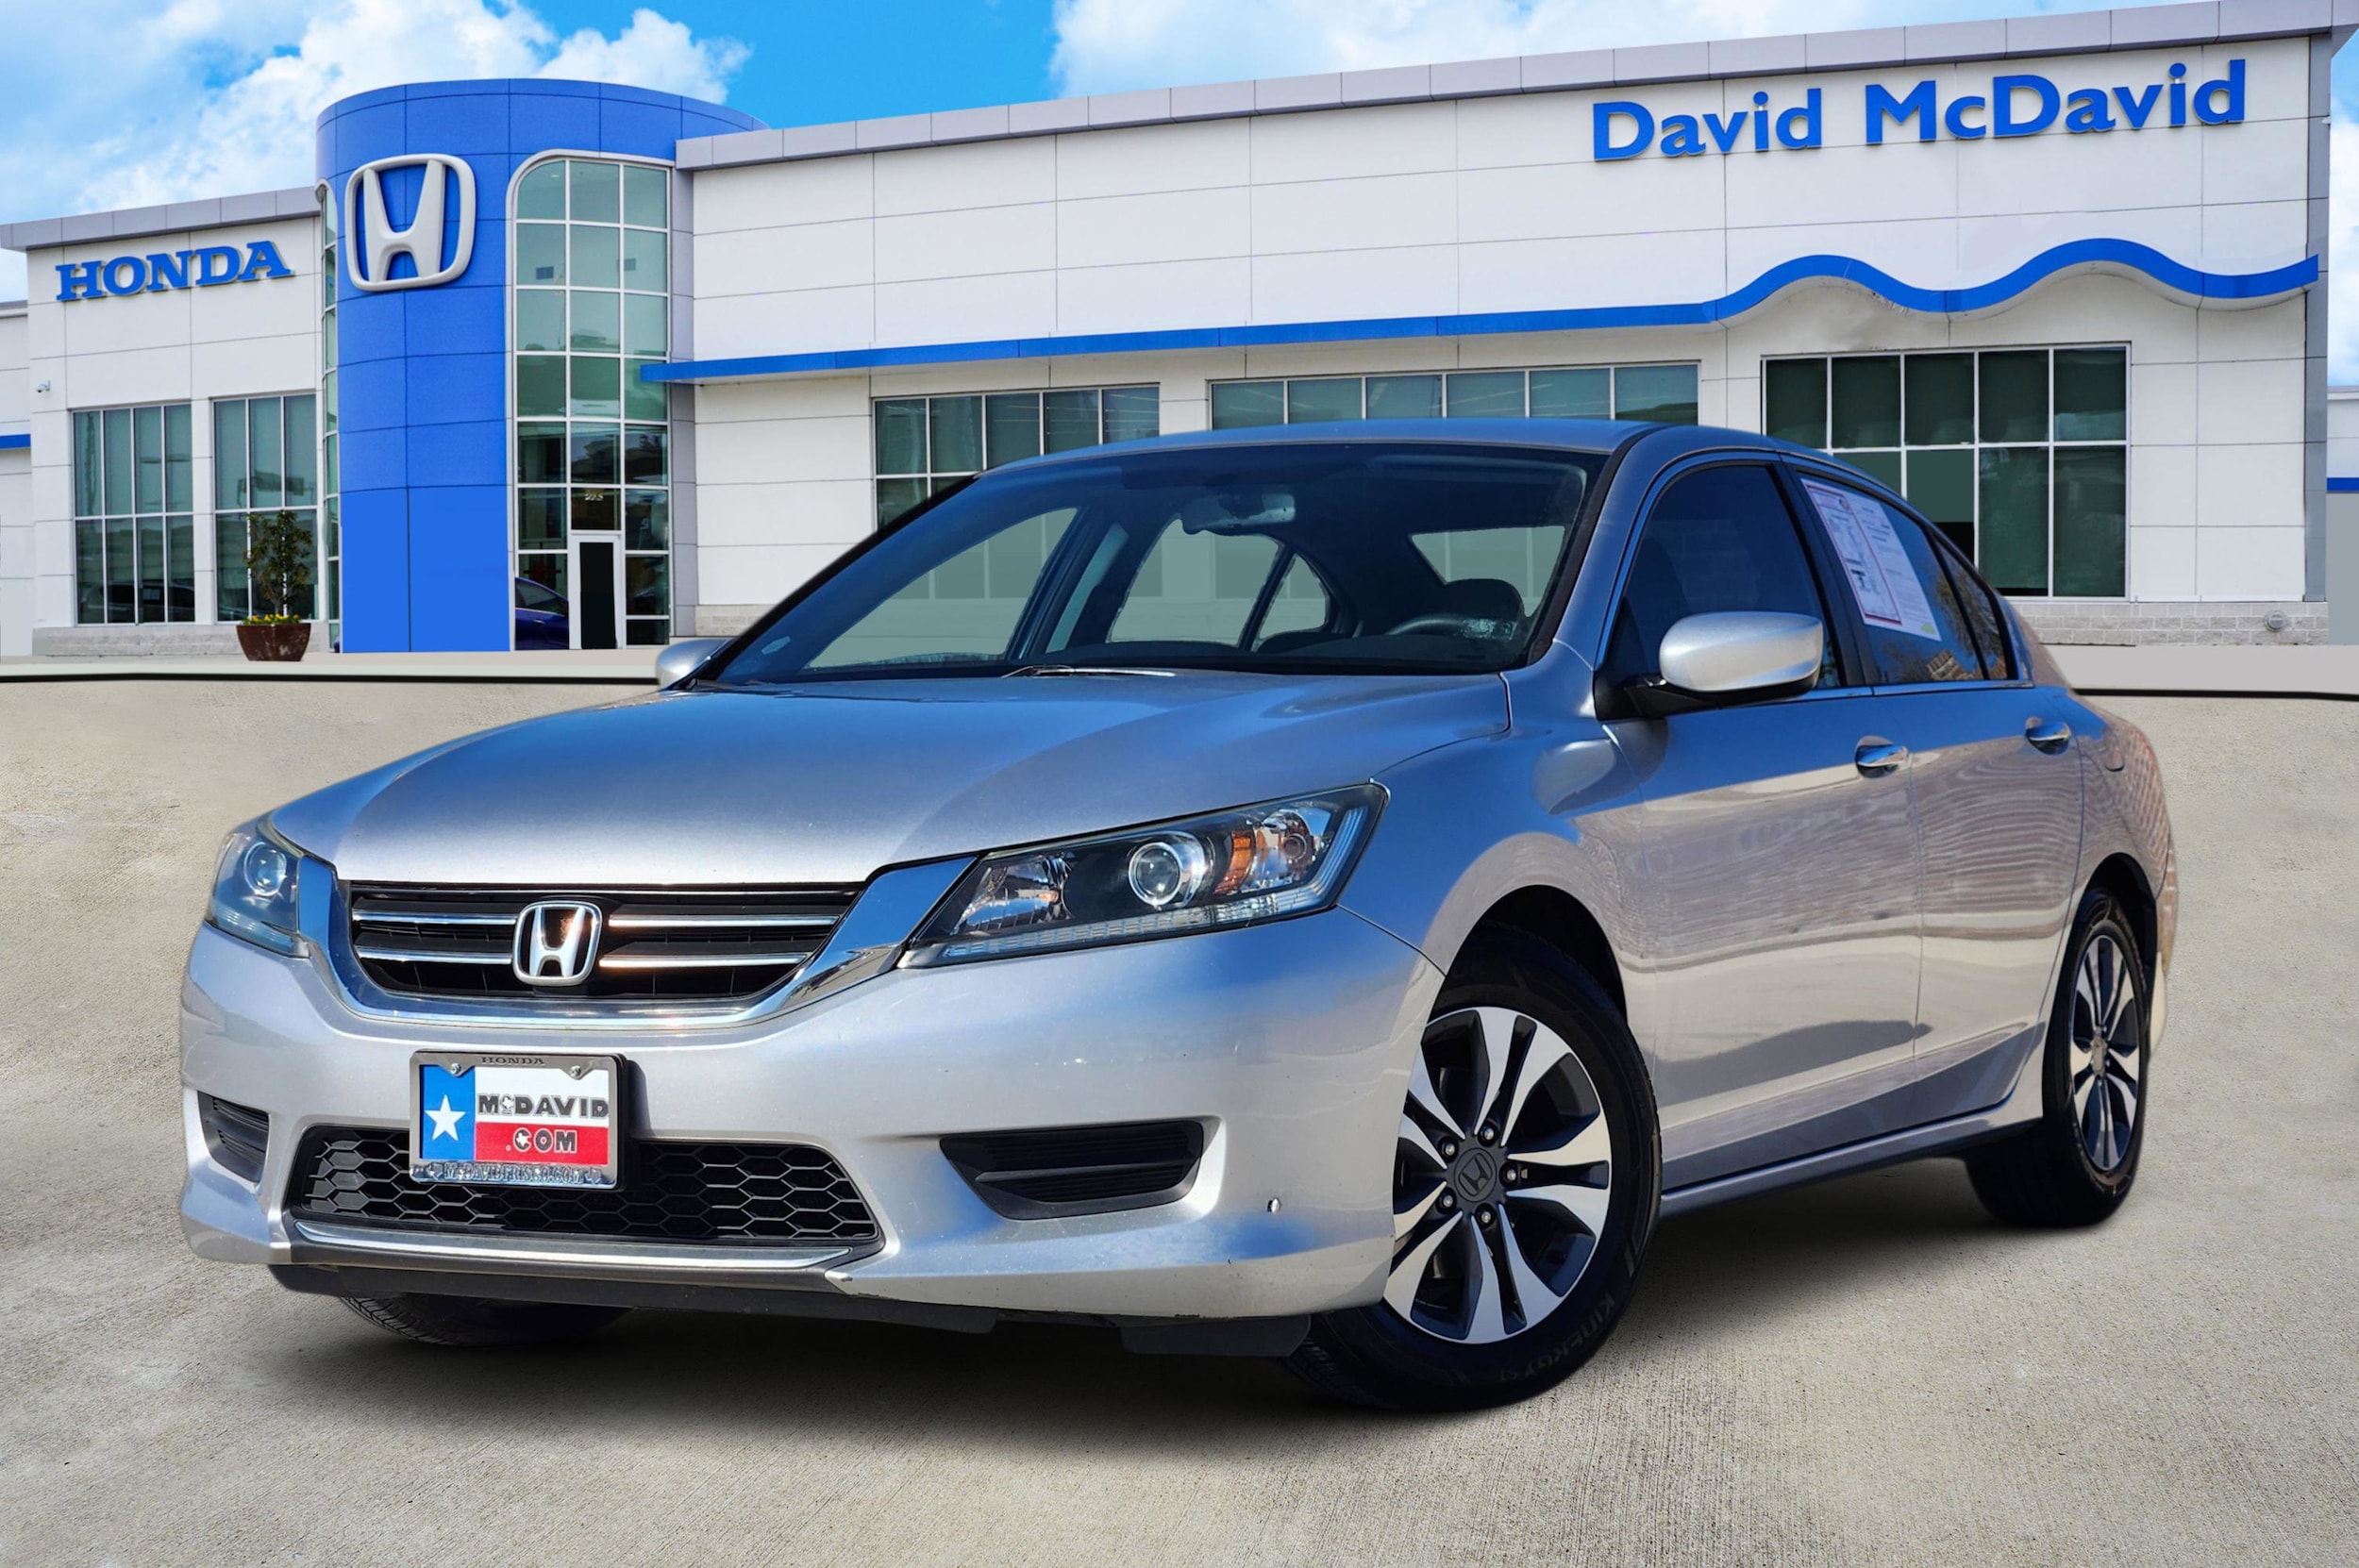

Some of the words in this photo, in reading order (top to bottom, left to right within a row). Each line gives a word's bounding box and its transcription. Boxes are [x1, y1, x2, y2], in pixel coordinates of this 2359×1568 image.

[1593, 88, 1822, 161] David
[1865, 58, 2246, 145] McDavid
[56, 240, 293, 302] HONDA
[480, 1056, 545, 1065] HONDA
